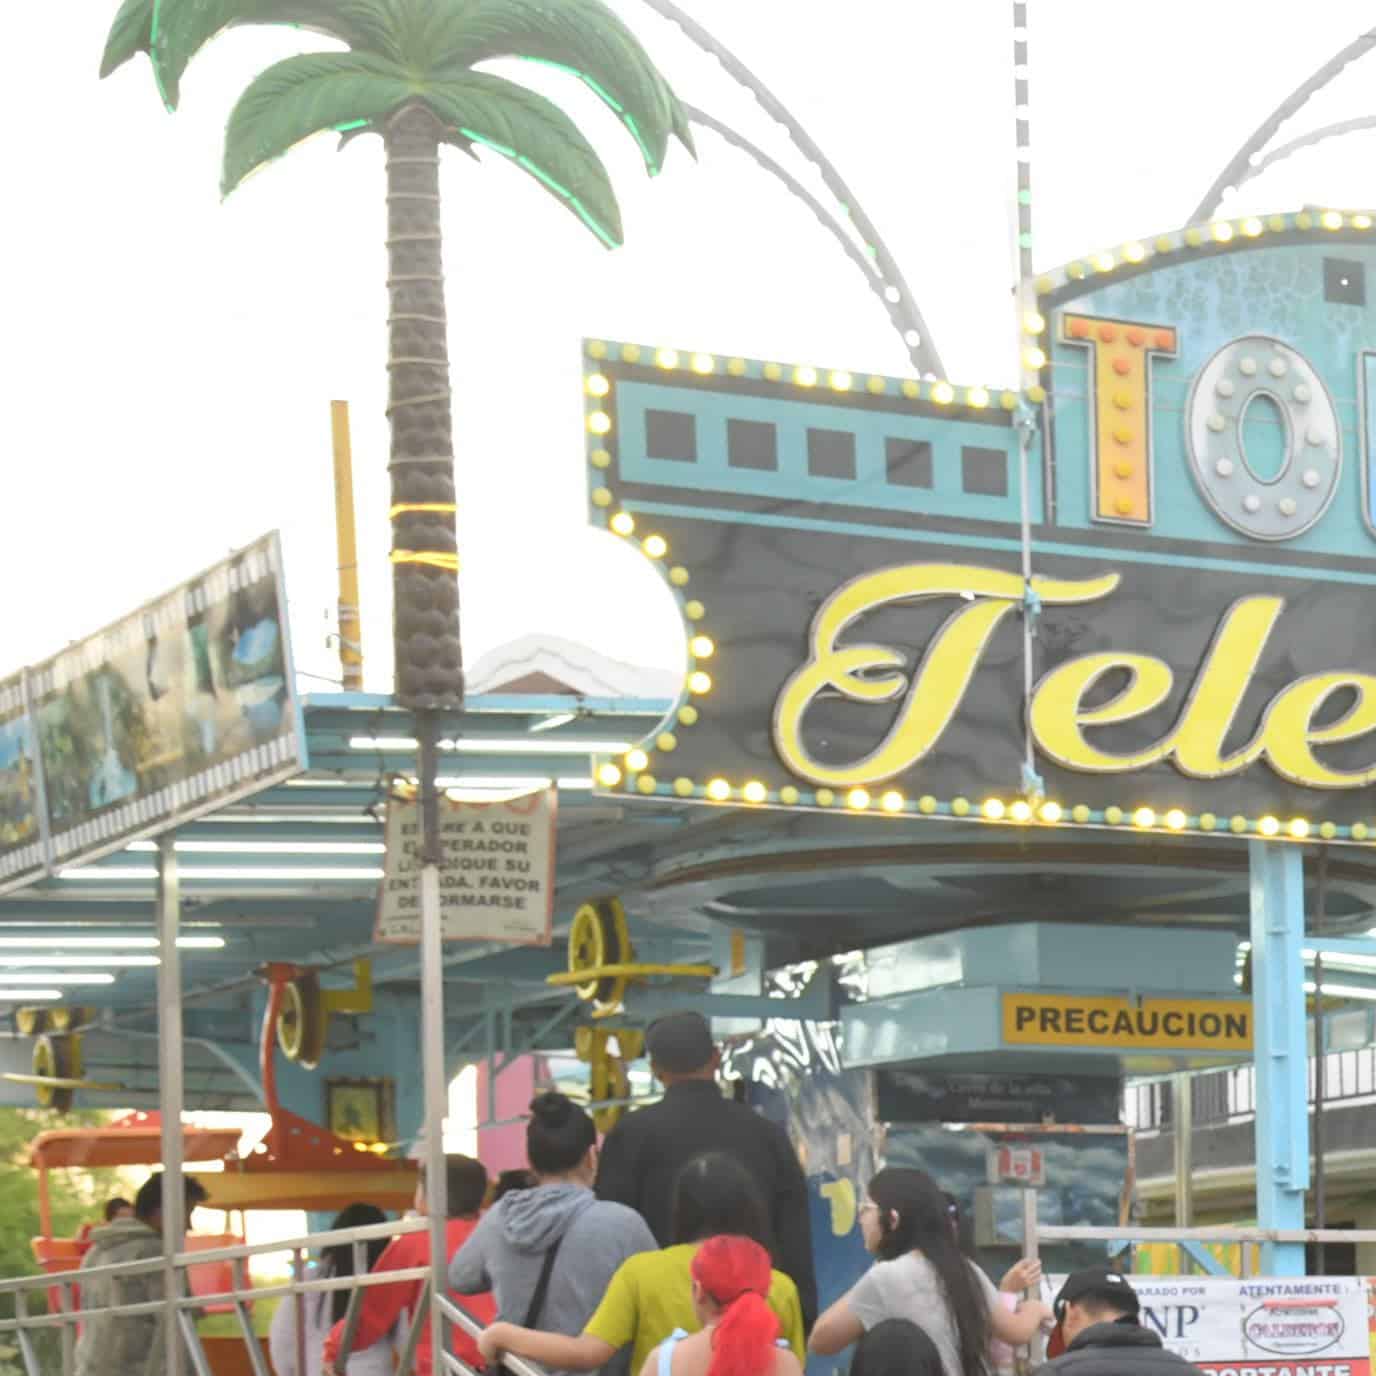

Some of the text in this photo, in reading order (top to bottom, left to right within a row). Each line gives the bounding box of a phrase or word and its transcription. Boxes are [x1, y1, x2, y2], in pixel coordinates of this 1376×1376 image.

[490, 822, 530, 836] QUE
[504, 859, 531, 873] SU
[479, 878, 540, 892] FAVOR
[1015, 1005, 1248, 1039] PRECAUCION
